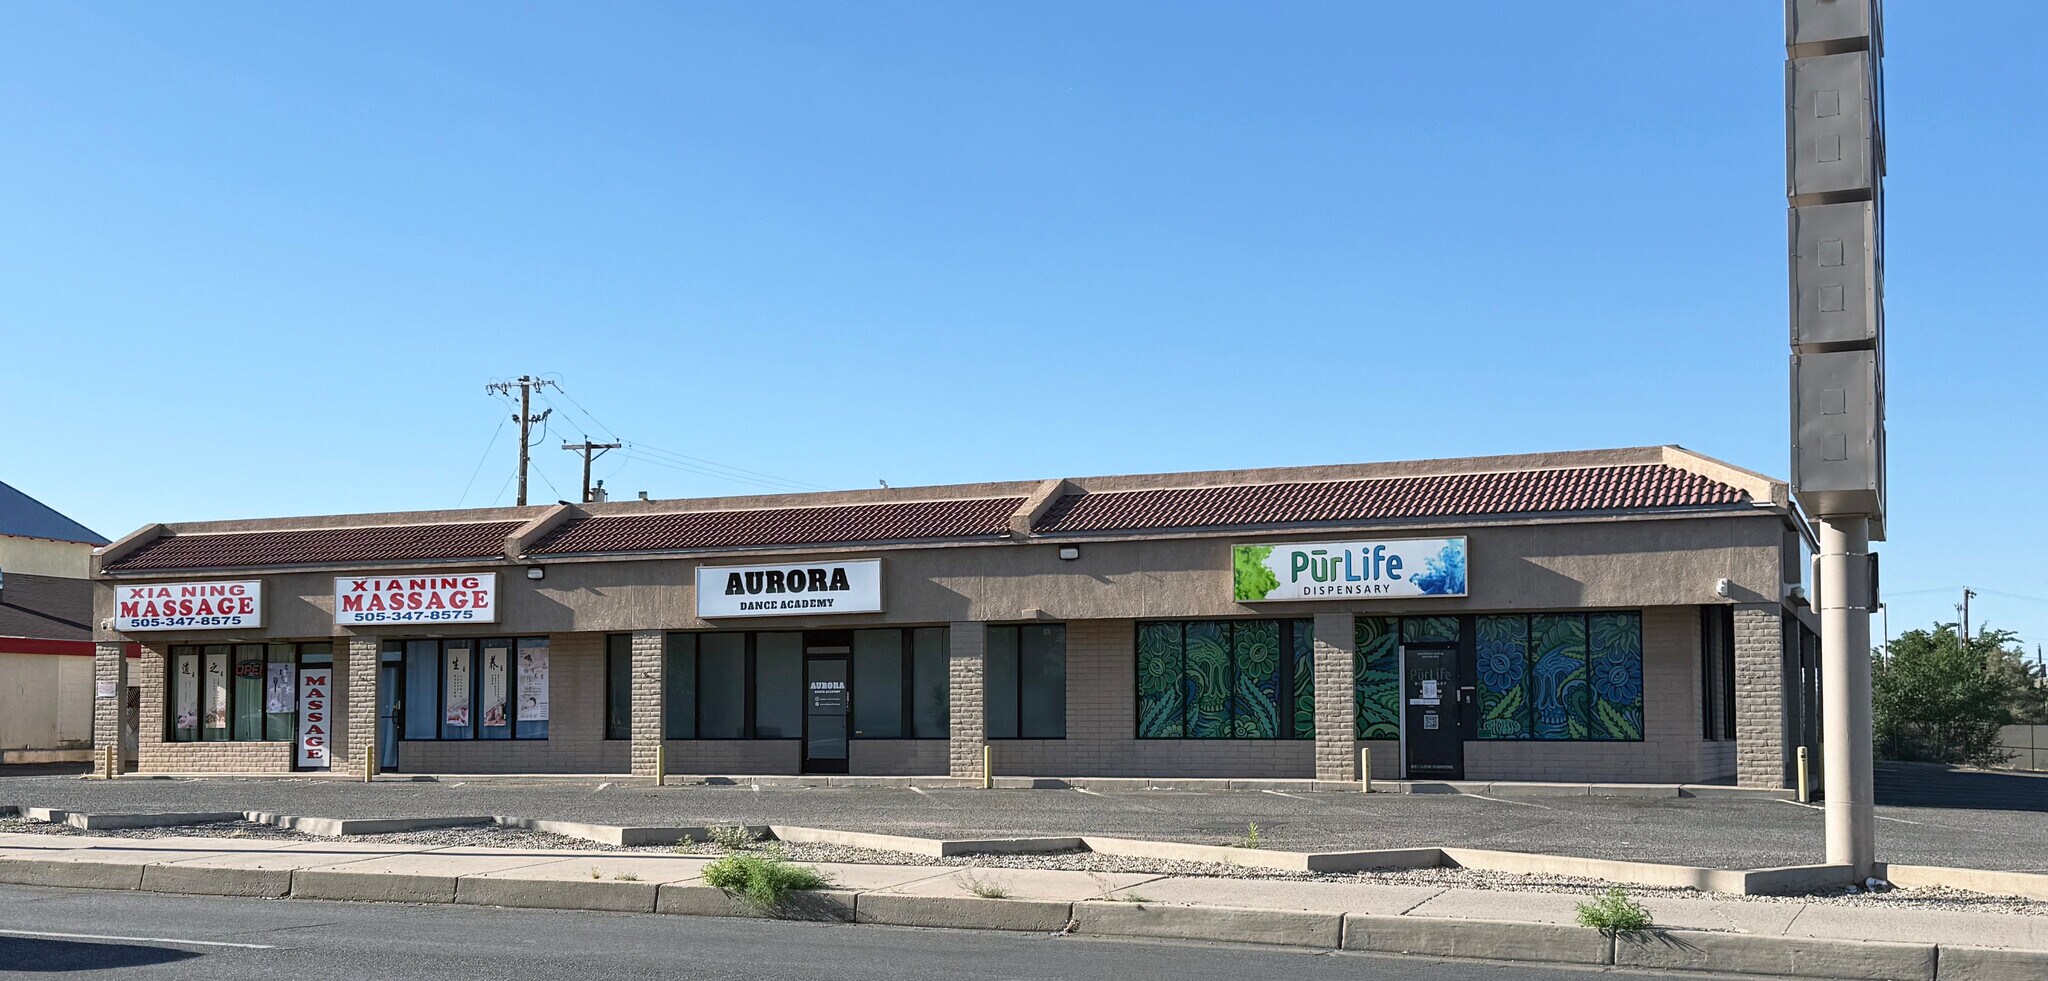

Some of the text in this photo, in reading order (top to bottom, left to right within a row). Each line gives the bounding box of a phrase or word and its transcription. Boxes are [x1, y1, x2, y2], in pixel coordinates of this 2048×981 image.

[351, 577, 480, 592] XIANING
[724, 567, 850, 596] AURORA
[130, 585, 246, 599] XIA NING
[1303, 584, 1390, 596] DISPENSARY
[120, 597, 254, 618] MASSAGE
[342, 590, 489, 612] MASSAGE
[740, 598, 835, 611] DANCE ACADEMY
[131, 616, 242, 628] 505-347-8575
[354, 610, 473, 622] 505-347-8575
[810, 681, 845, 690] AURORA
[305, 676, 327, 759] MASSAGE
